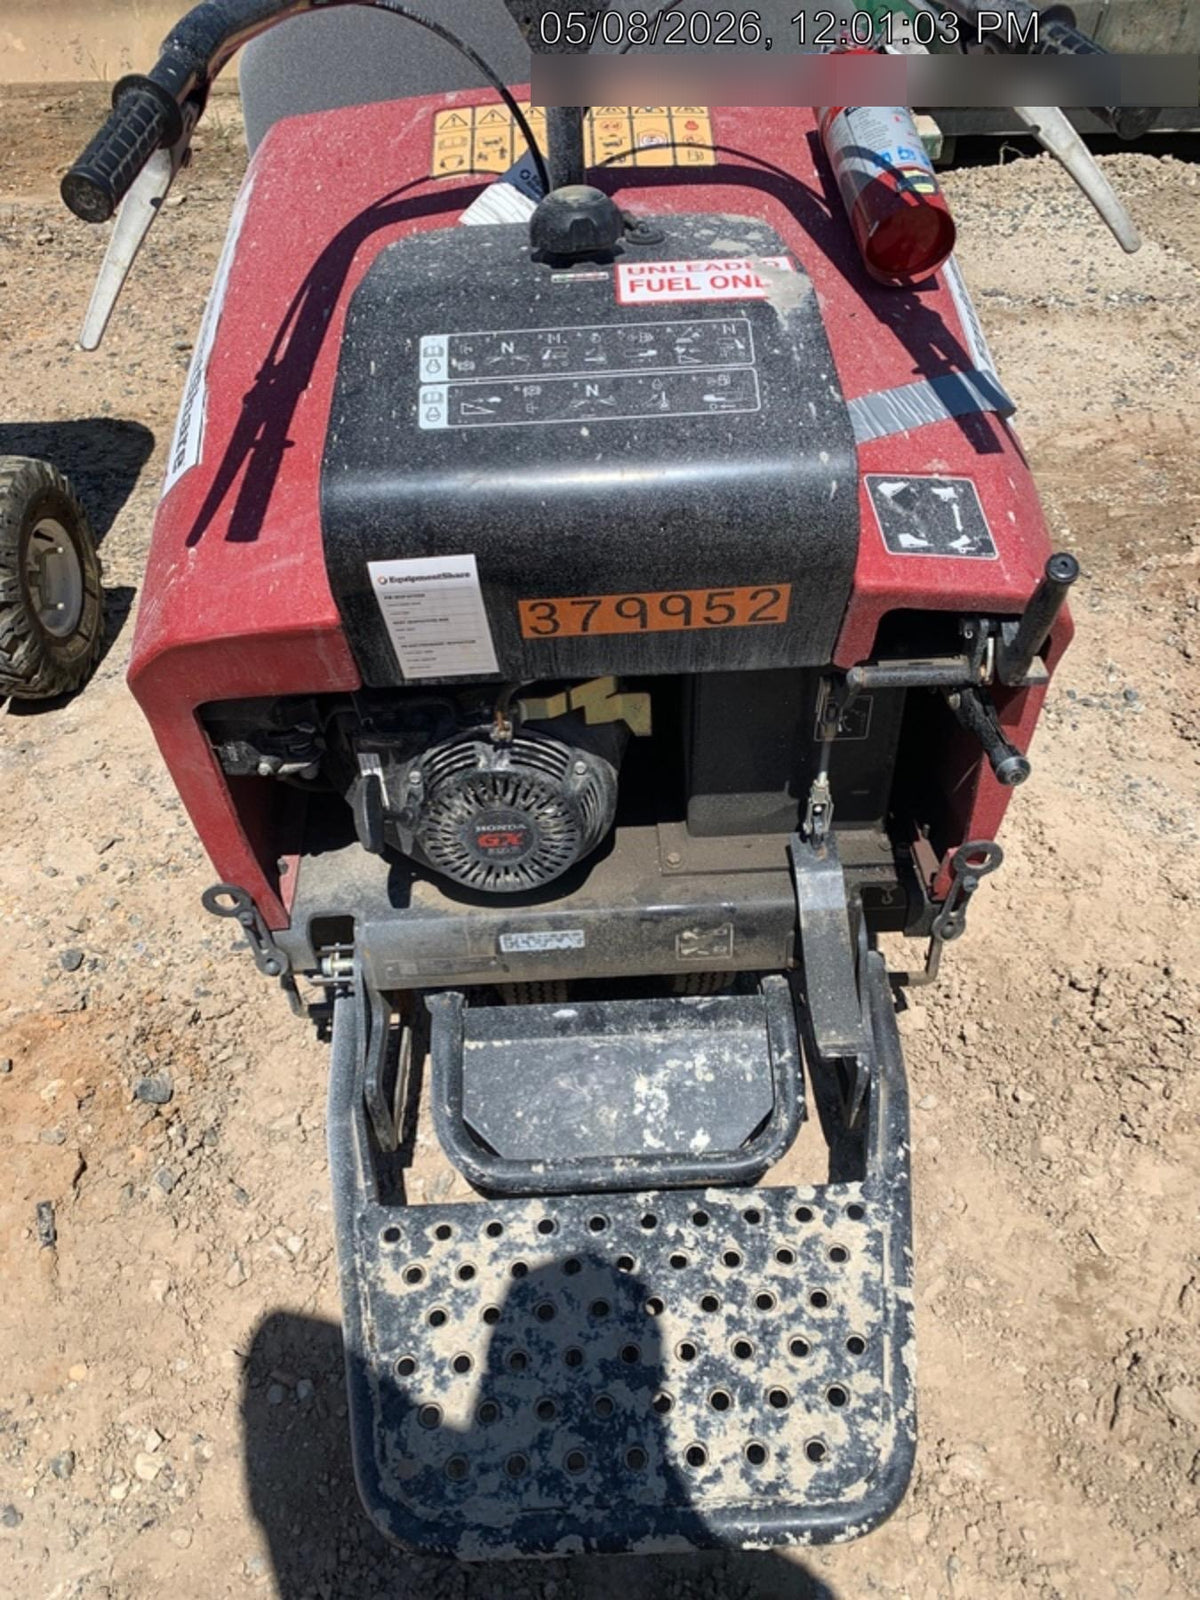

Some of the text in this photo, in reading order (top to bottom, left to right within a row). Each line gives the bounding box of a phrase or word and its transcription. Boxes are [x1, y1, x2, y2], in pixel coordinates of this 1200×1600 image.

[629, 277, 700, 293] FUEL
[709, 274, 770, 290] ONL
[501, 341, 515, 354] N
[586, 384, 599, 397] N
[389, 572, 471, 583] EquipmentShare
[528, 587, 782, 635] 379952
[475, 824, 527, 832] HONDA
